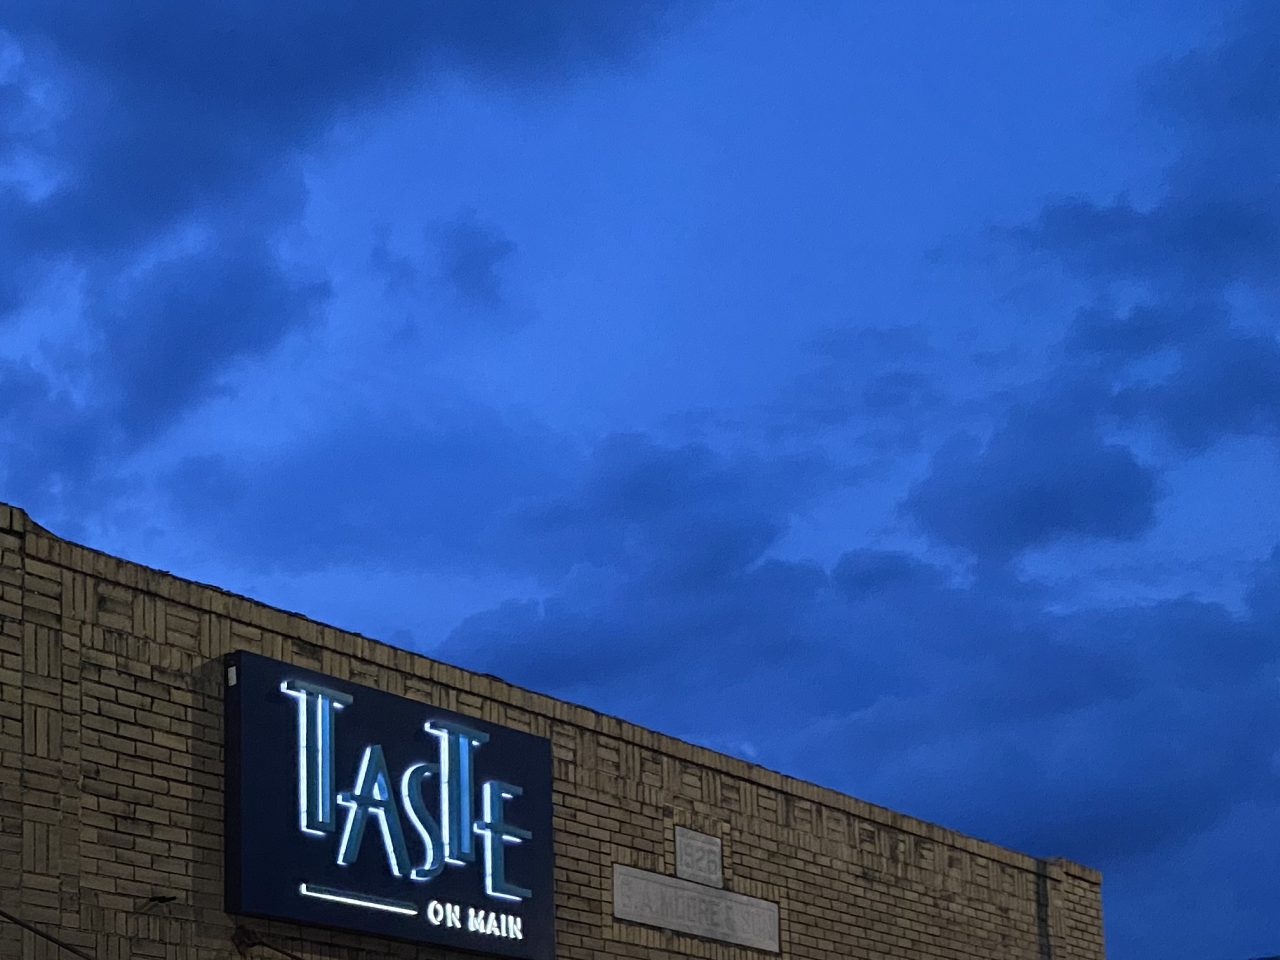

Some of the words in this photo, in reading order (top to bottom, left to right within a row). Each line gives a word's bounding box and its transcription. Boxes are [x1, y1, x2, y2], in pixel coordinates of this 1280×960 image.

[280, 679, 532, 901] TASTE
[427, 900, 461, 928] ON
[468, 907, 523, 940] MAIN
